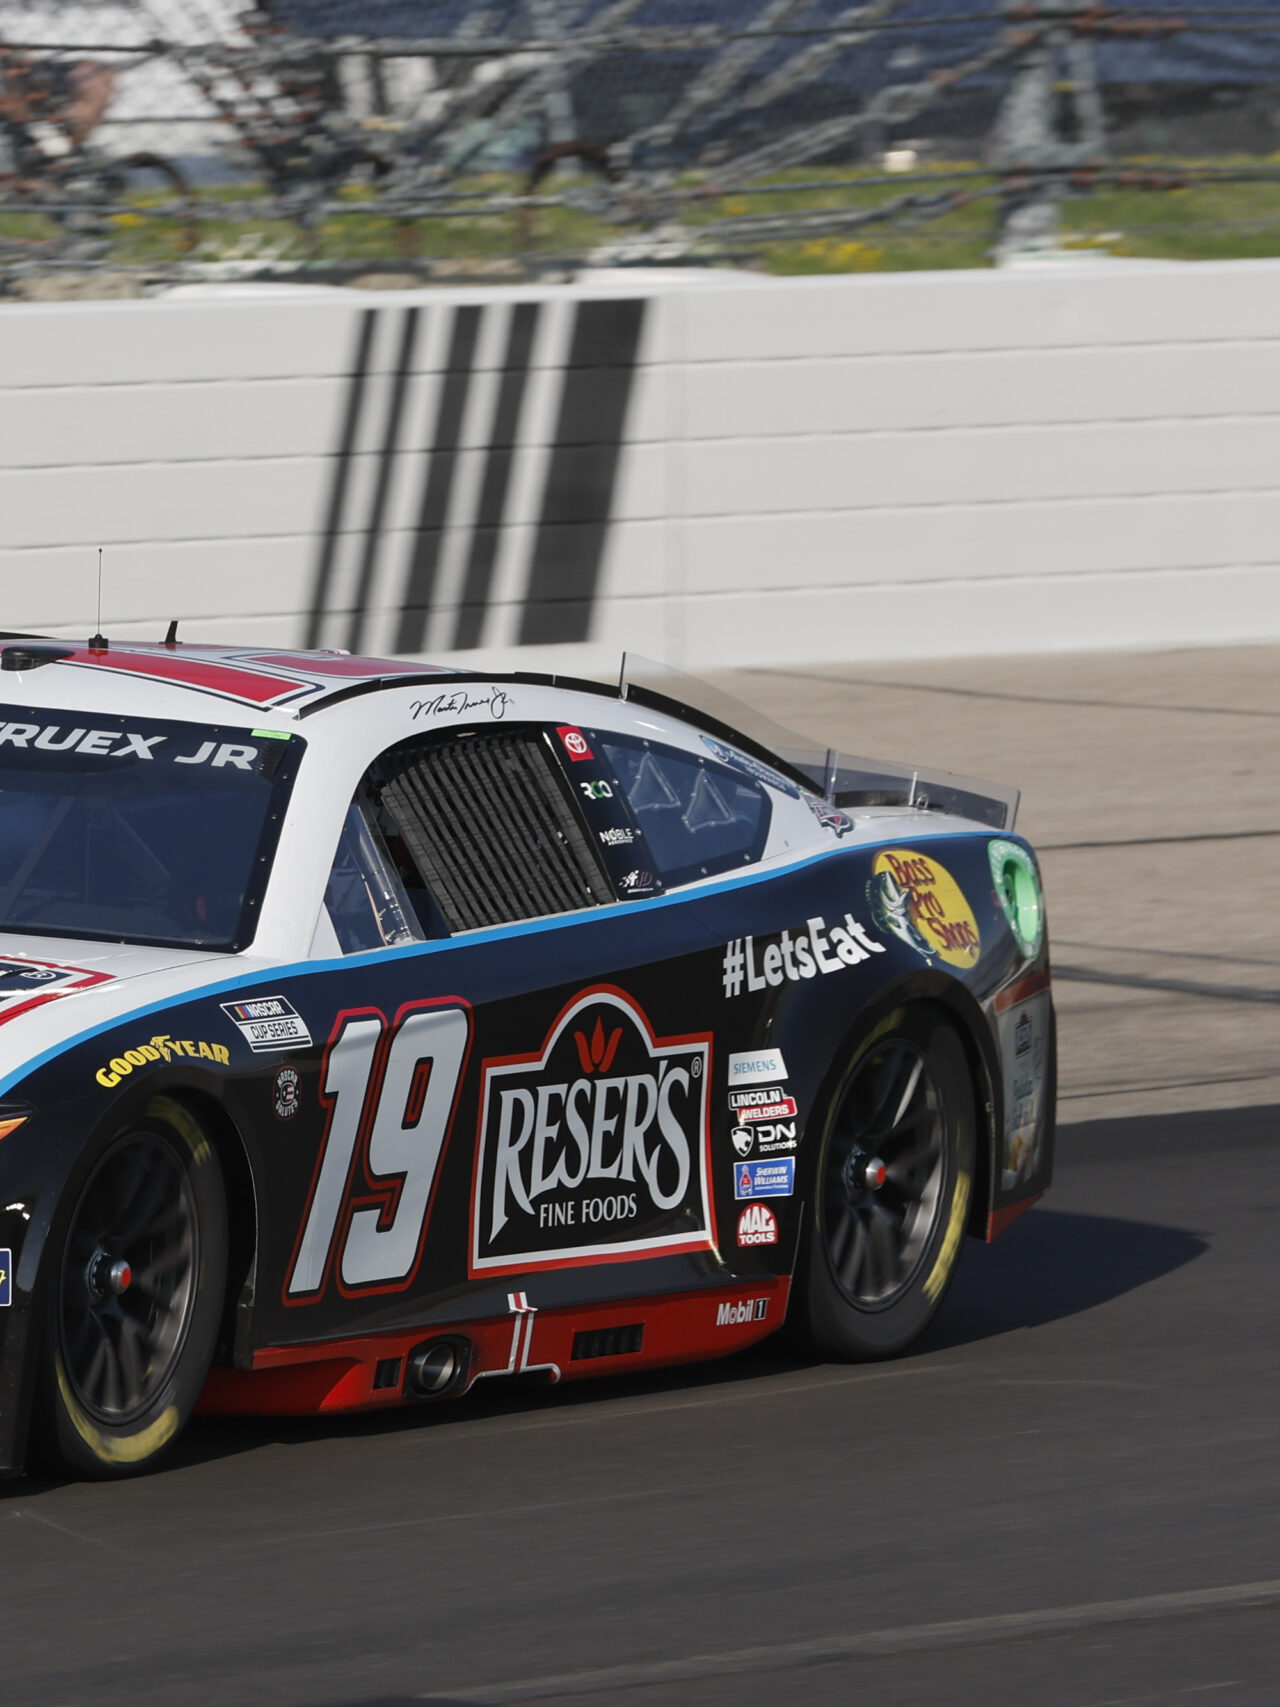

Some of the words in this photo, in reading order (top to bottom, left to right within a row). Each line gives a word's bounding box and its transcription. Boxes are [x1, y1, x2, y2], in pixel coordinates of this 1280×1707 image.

[173, 739, 261, 771] JR
[883, 853, 936, 886] Bass
[910, 885, 946, 920] Pro
[926, 917, 980, 951] Shops
[722, 913, 887, 999] #LetsEat
[244, 1000, 286, 1019] NASCAR
[250, 1025, 269, 1040] CUP
[269, 1020, 299, 1037] SERIES
[95, 1034, 231, 1089] GOODYEAR
[733, 1060, 777, 1075] SIEMENS
[730, 1090, 782, 1108] LINCOLN
[741, 1104, 790, 1119] WELDERS
[756, 1121, 797, 1143] DN
[286, 1004, 470, 1299] 19
[755, 1166, 788, 1177] SHERWIN
[539, 1201, 576, 1229] FINE
[581, 1193, 638, 1224] FOODS
[738, 1205, 776, 1235] MAC
[738, 1231, 776, 1245] TOOLS
[716, 1299, 754, 1326] Mobil
